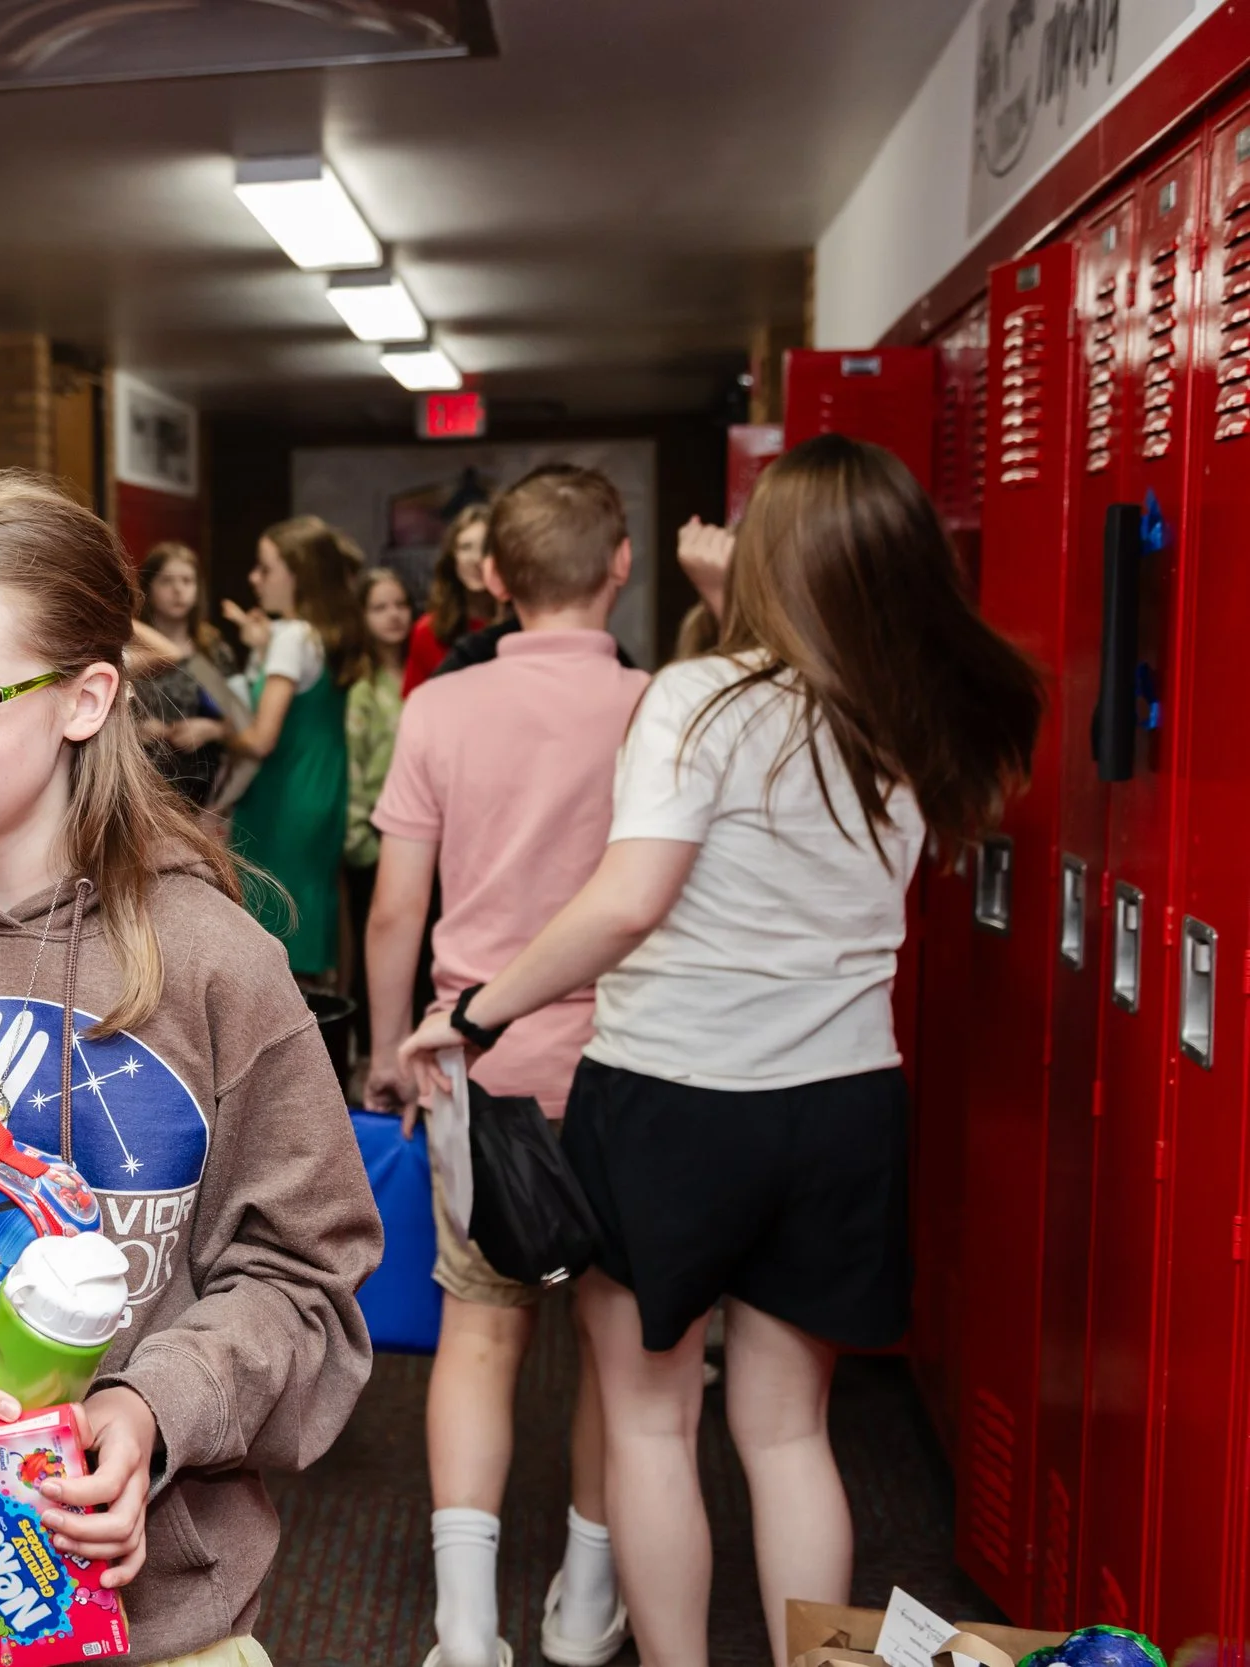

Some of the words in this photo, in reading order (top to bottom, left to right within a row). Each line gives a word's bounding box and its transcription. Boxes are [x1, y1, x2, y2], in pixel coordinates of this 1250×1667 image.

[106, 1190, 196, 1235] VIOR
[11, 1536, 55, 1598] Gummy
[17, 1518, 60, 1581] Clusters
